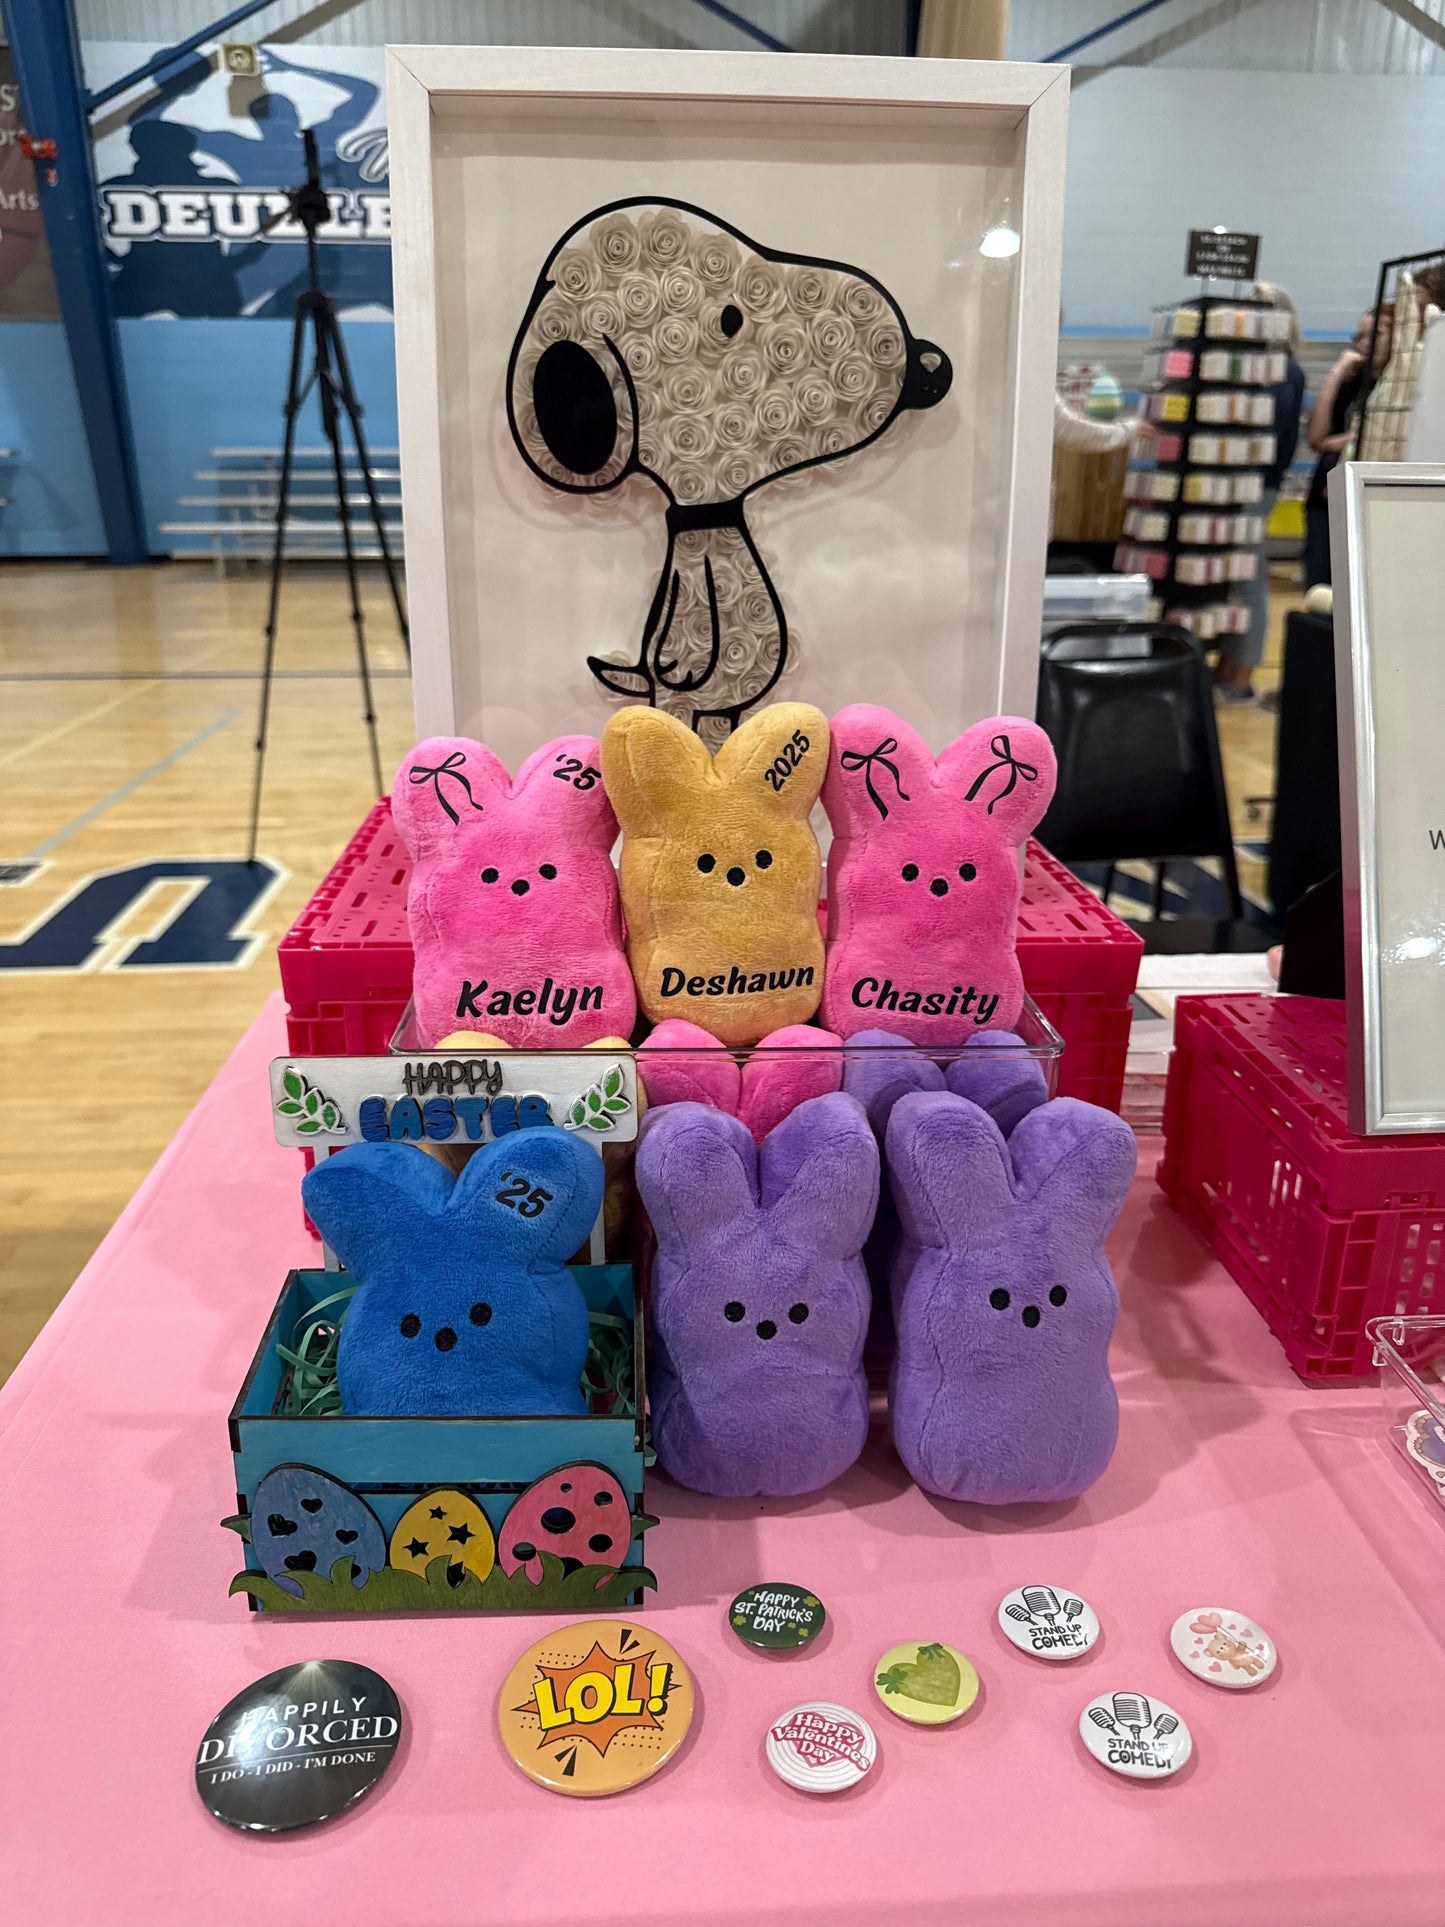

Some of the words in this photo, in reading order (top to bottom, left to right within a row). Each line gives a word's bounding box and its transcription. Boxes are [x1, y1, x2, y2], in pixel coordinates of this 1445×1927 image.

[553, 753, 602, 791] '25
[764, 729, 811, 792] 2025
[660, 966, 814, 998] Deshawn
[456, 977, 604, 1026] Kaelyn
[851, 977, 999, 1025] Chasity
[402, 1059, 502, 1096] HAPPY
[359, 1095, 555, 1142] EASTER
[496, 1172, 553, 1218] '25
[735, 1602, 756, 1615] ST.
[758, 1604, 813, 1623] PATRICK'S
[754, 1591, 799, 1608] HAPPY
[753, 1616, 786, 1632] DAY
[1029, 1625, 1065, 1637] STAND
[1068, 1624, 1081, 1633] UP
[533, 1663, 672, 1731] LOL!
[197, 1716, 398, 1765] DIORCED
[794, 1713, 864, 1744] Happy
[1107, 1738, 1150, 1751] STAND
[210, 1773, 217, 1784] I
[221, 1768, 245, 1782] DO
[256, 1765, 262, 1776] I
[265, 1761, 293, 1774] DID
[304, 1757, 327, 1769] I'M
[331, 1752, 376, 1765] DONE
[800, 1741, 836, 1763] Day
